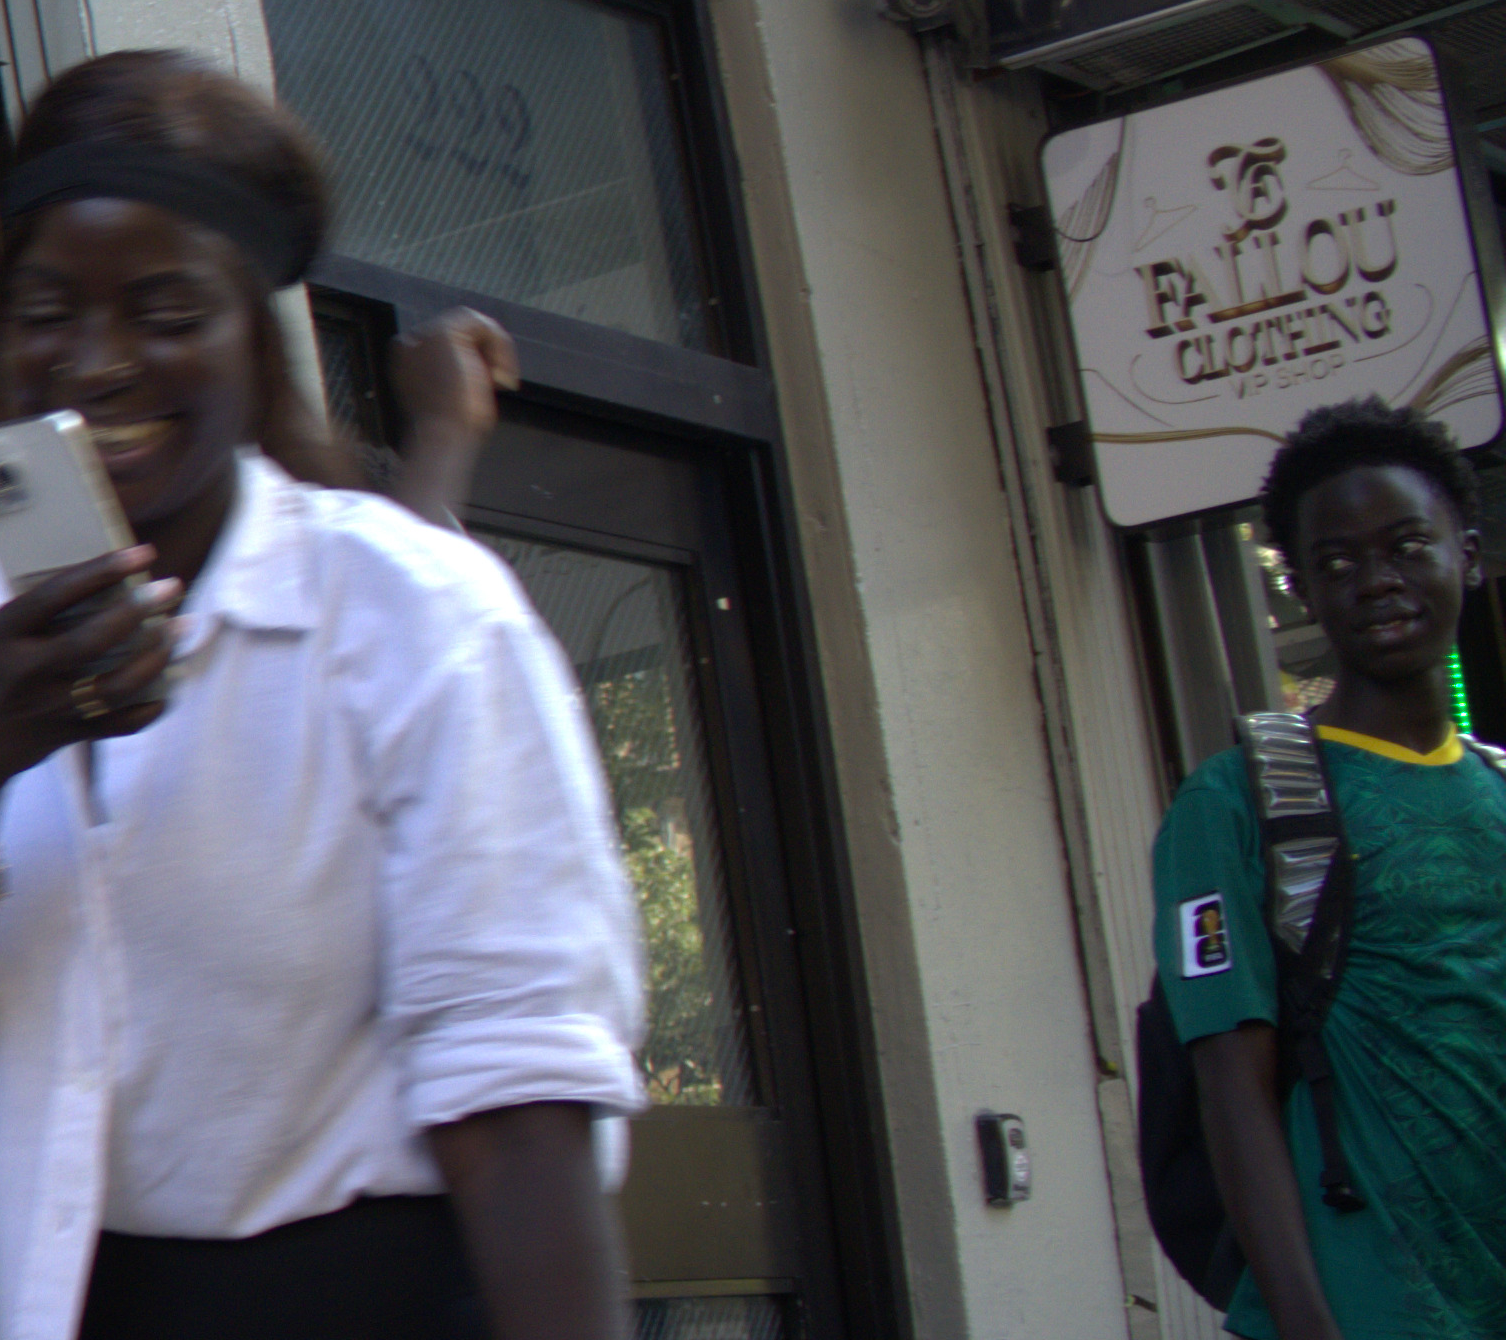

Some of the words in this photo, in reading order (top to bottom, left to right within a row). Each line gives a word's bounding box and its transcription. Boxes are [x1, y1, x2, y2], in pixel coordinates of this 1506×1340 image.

[1134, 198, 1397, 340] FALLOU
[1174, 290, 1393, 385] CLOTHING
[1231, 372, 1270, 400] VIP
[1277, 353, 1346, 390] SHOP
